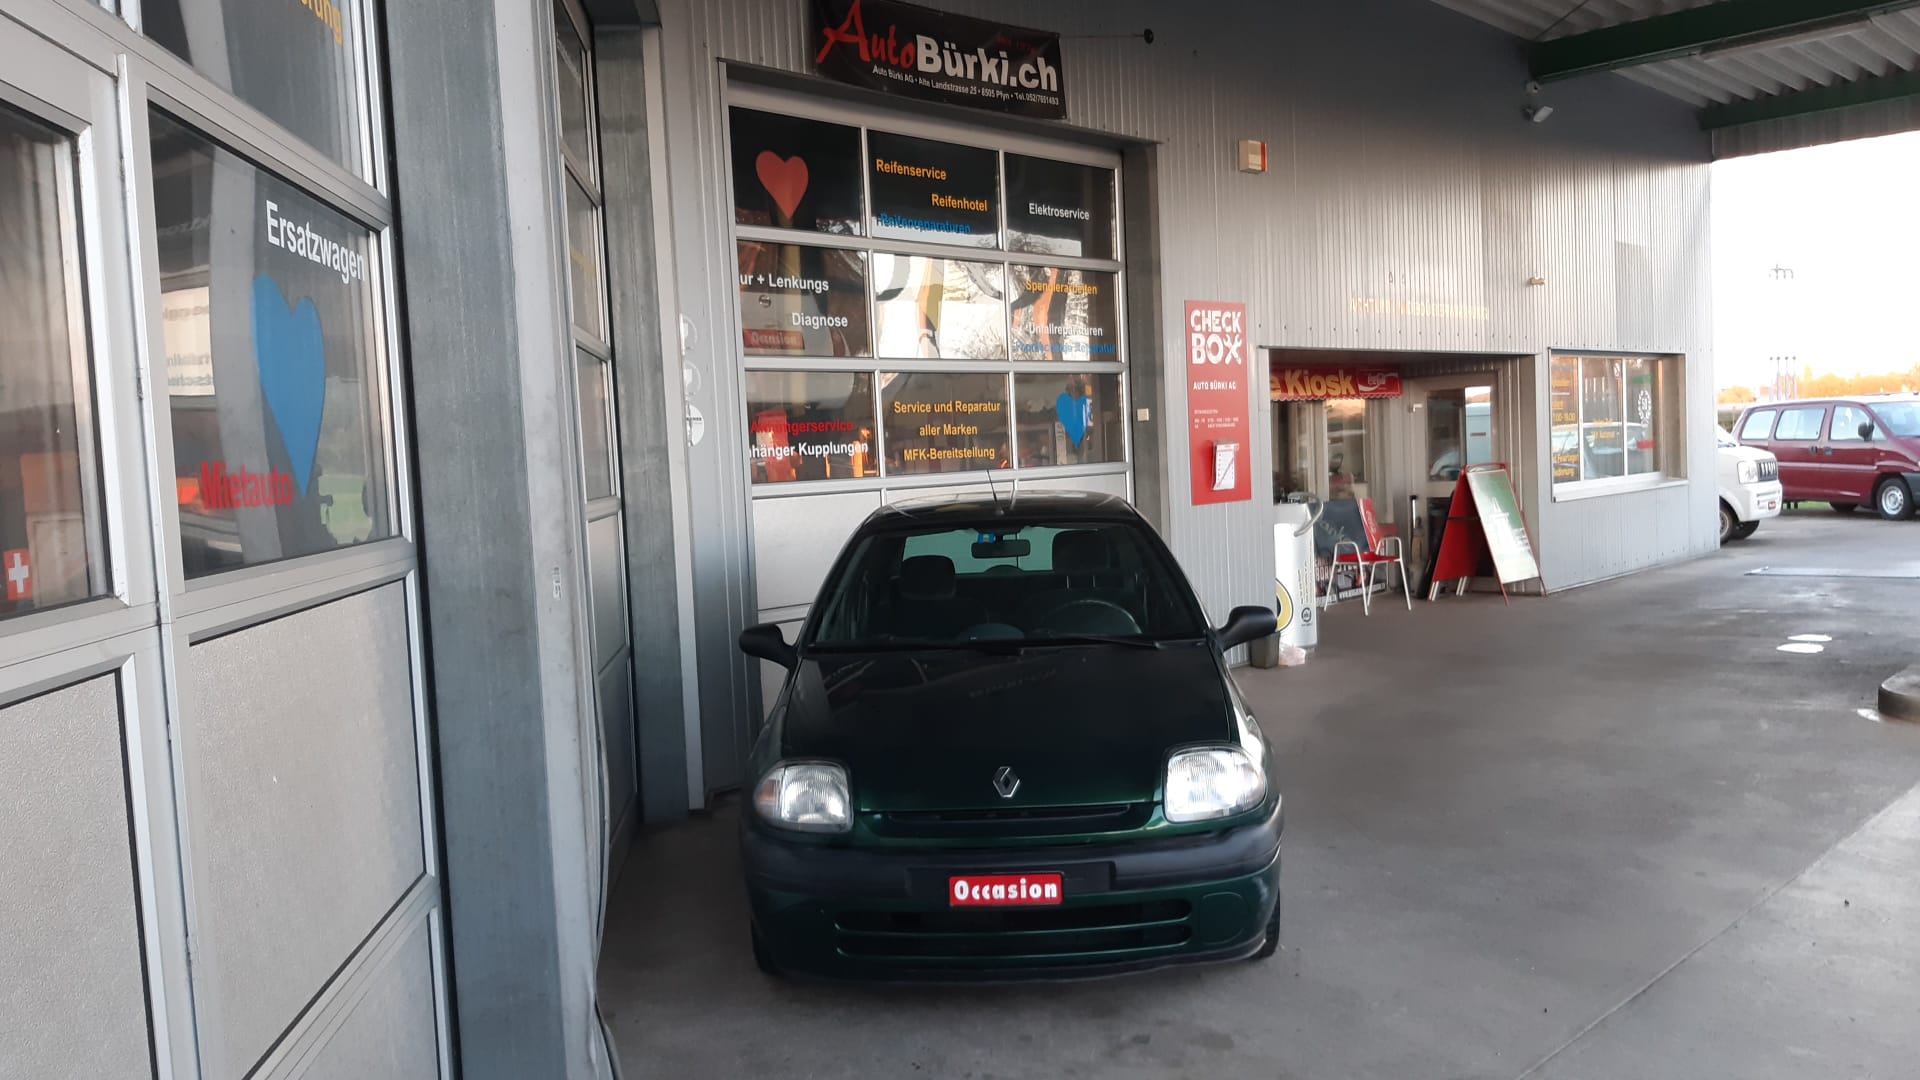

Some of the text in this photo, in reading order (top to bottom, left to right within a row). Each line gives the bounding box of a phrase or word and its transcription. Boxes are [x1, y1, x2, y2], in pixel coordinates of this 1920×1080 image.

[872, 64, 888, 76] Auto
[888, 68, 904, 81] Bürki
[904, 74, 914, 84] AG
[931, 79, 969, 94] Landstrasse
[876, 159, 947, 180] Reifenservice
[931, 193, 988, 212] Reifenhotel
[1028, 202, 1090, 220] Elektroservice
[266, 200, 366, 285] Ersatzwagen
[768, 273, 830, 294] Lenkungs
[791, 312, 849, 330] Diagnose
[1190, 309, 1242, 333] CHECK
[1191, 333, 1243, 365] BOX
[1193, 379, 1237, 390] AUTO BÜRKI AG
[1284, 368, 1356, 397] Kiosk
[894, 400, 1001, 414] Service und Reparatur
[919, 423, 978, 436] aller Marken
[798, 441, 869, 458] Kupplungen
[903, 446, 996, 462] MFK-Bereitstellung
[201, 461, 294, 510] Mietauto
[954, 878, 1057, 900] Occasion
